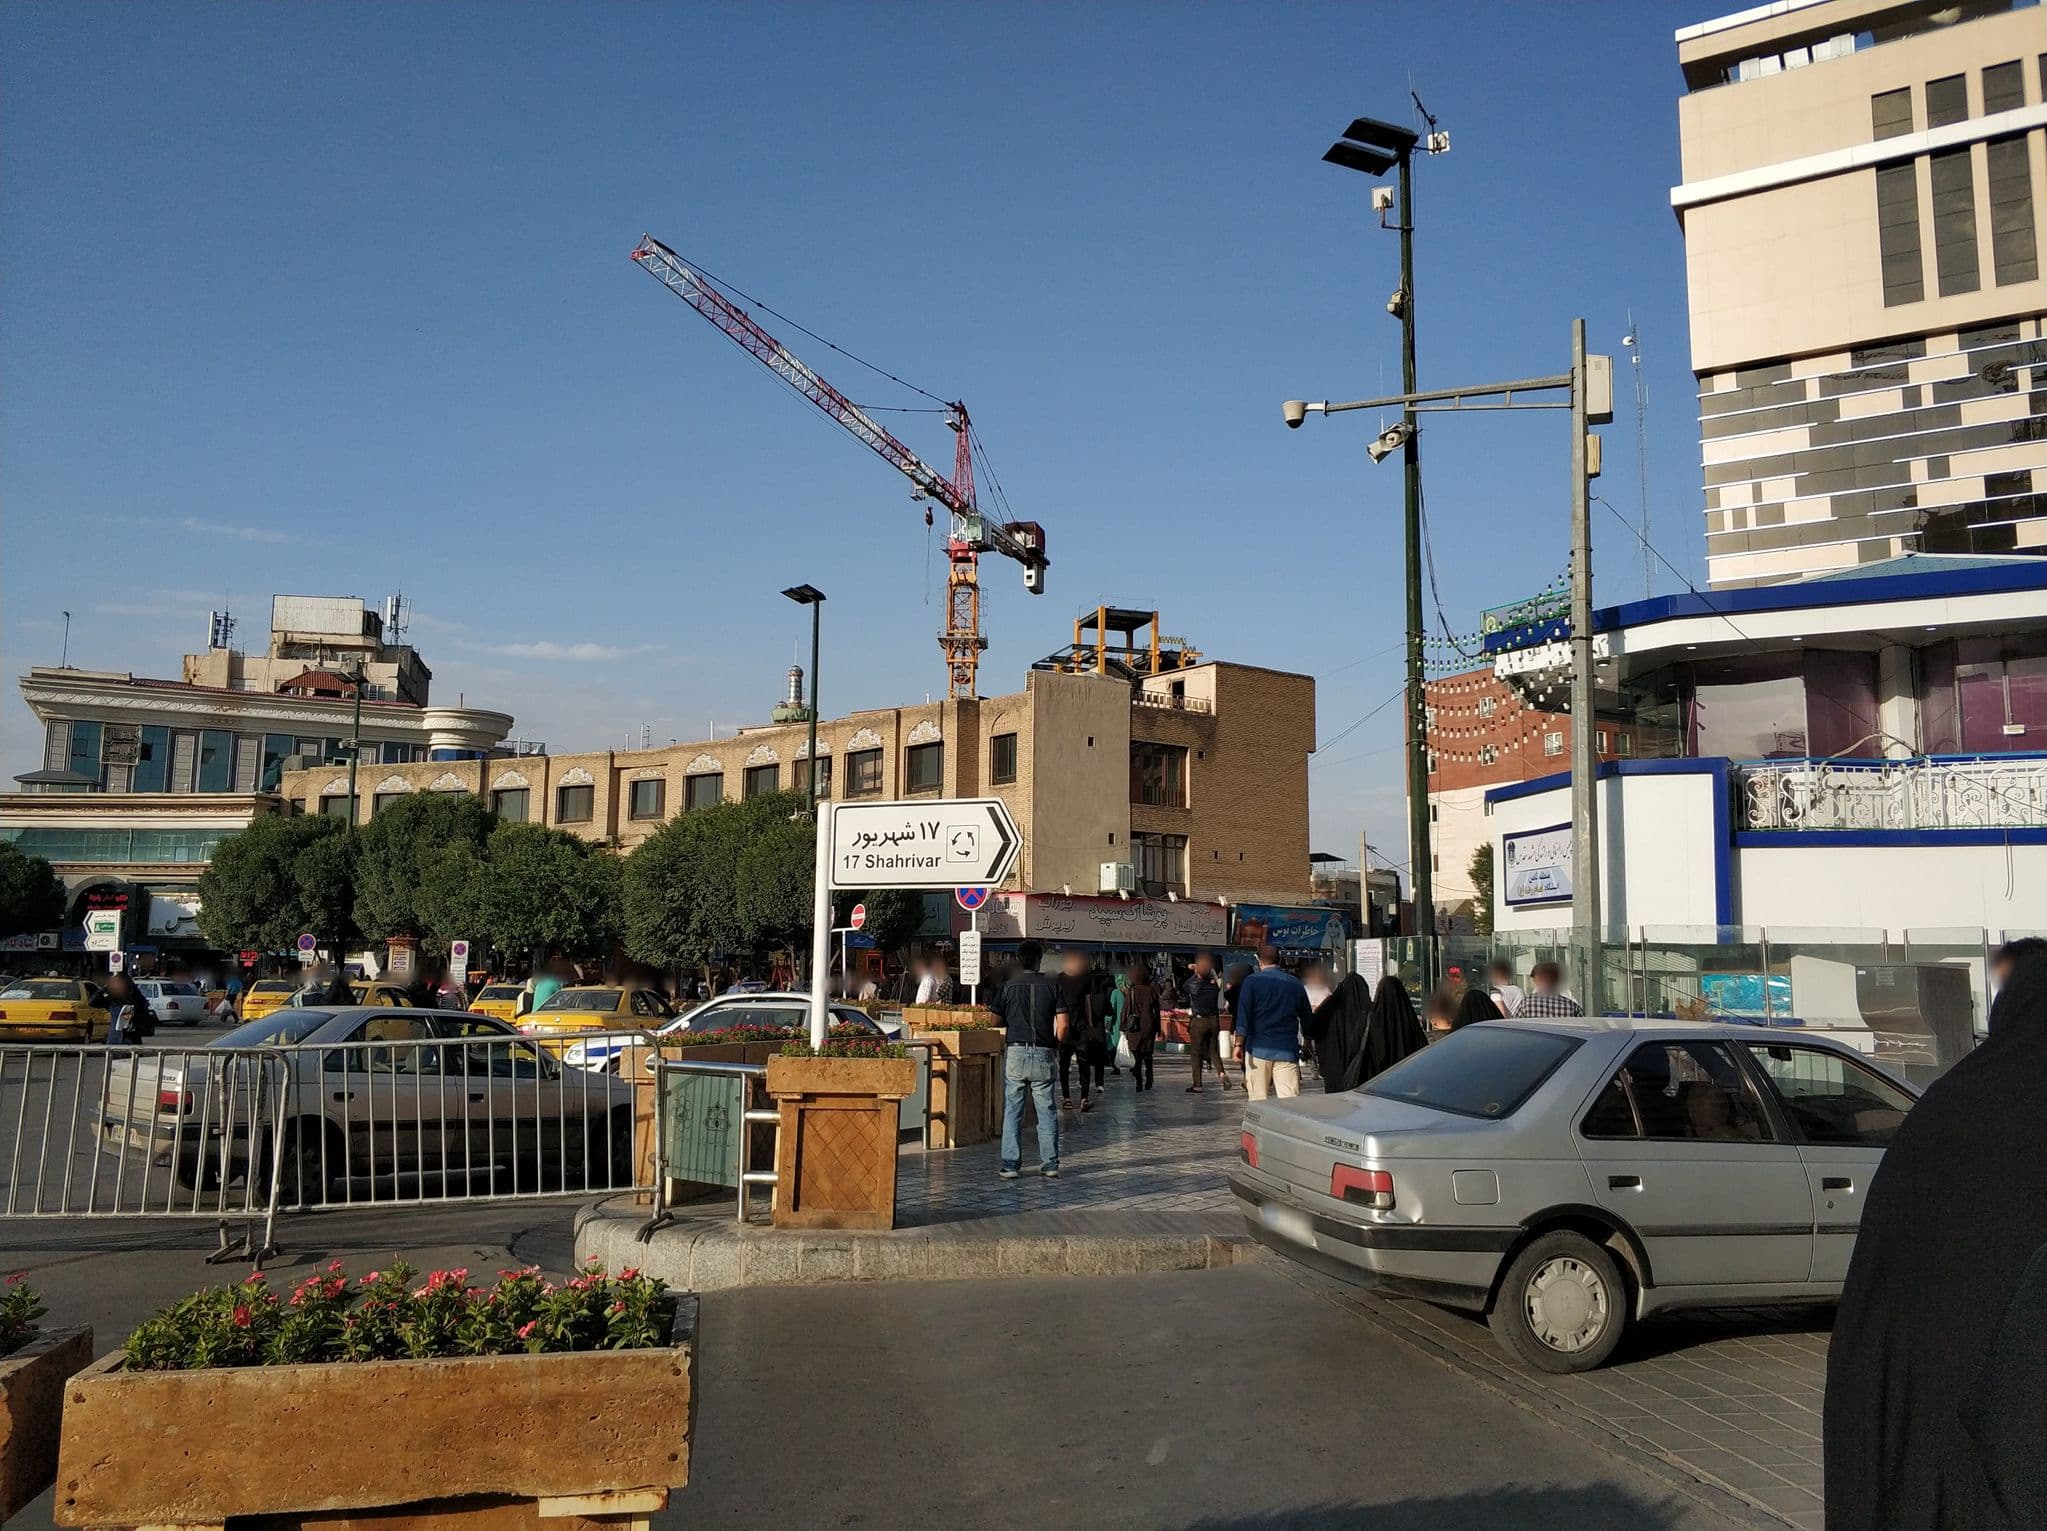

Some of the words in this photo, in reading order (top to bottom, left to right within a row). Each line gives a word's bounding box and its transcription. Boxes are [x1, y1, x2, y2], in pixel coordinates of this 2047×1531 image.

[852, 822, 916, 849] شهریور
[919, 821, 940, 840] ۱۷
[843, 855, 860, 870] 17
[865, 853, 941, 868] Shahrivar
[1038, 897, 1074, 912] جوراب
[1089, 904, 1122, 927] سپید
[1122, 903, 1169, 929] پوشاک
[1035, 916, 1076, 936] زیرپوش
[1291, 924, 1319, 939] خاطرات
